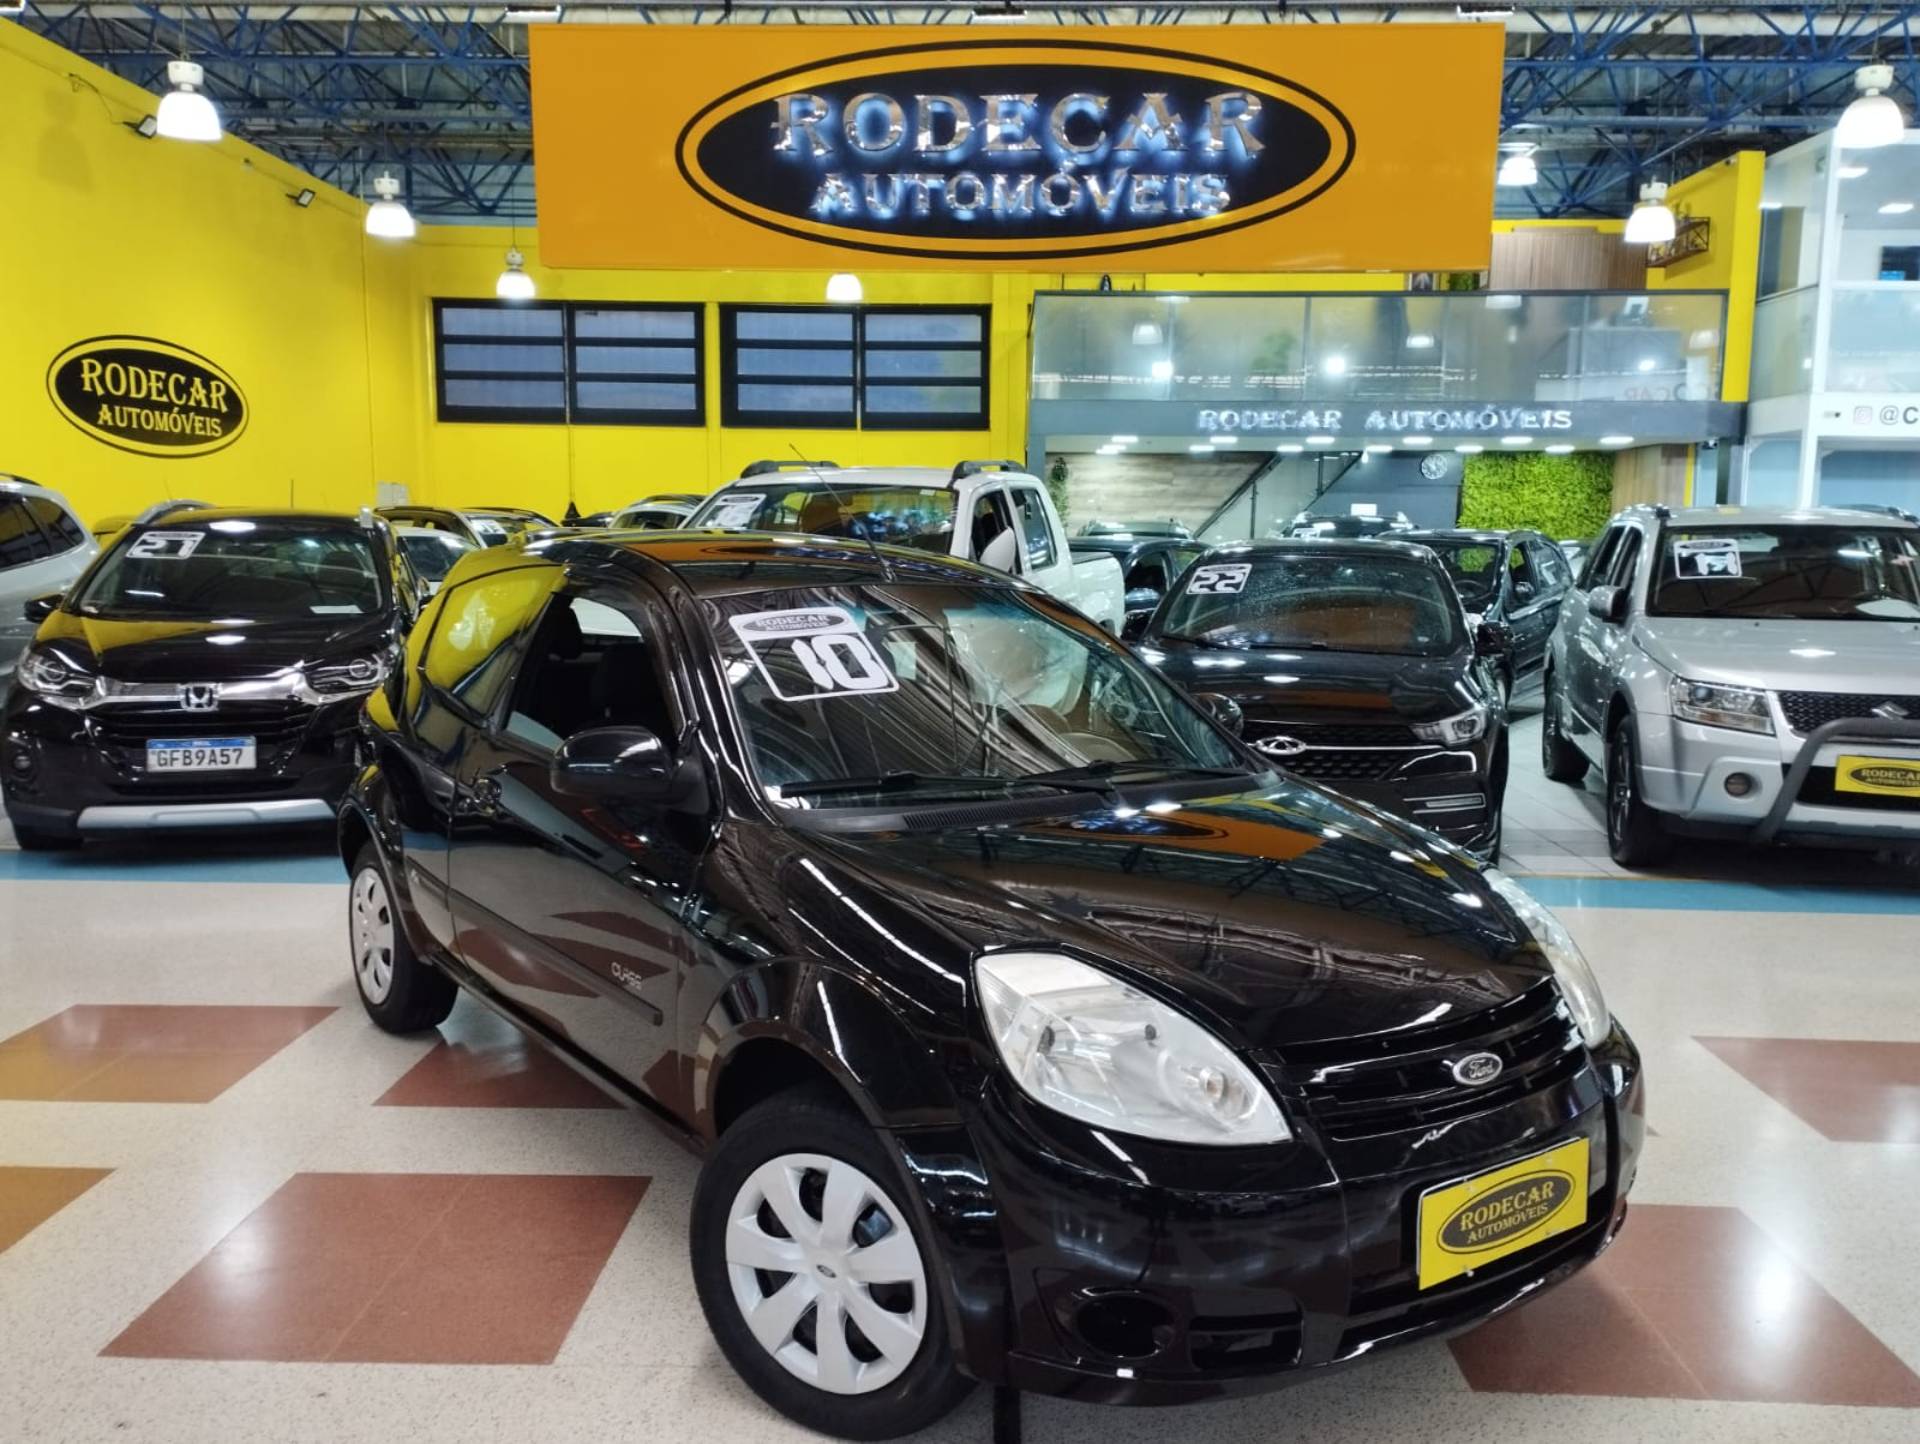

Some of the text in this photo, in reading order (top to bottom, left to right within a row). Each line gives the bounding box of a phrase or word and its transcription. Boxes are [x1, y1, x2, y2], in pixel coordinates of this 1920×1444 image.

[769, 91, 1266, 159] RODECAR
[809, 165, 1231, 217] AUTOMÓVEIS
[81, 358, 229, 413] RODECAR
[97, 403, 223, 437] AUTOMÓVEIS
[1199, 404, 1573, 431] RODECAR AUTOMÓVEIS
[1189, 571, 1245, 593] 22
[791, 634, 889, 690] 10
[157, 748, 244, 768] GFB9A57
[1861, 768, 1920, 781] RODECA
[1468, 1059, 1495, 1079] Ford
[1460, 1181, 1555, 1232] RODECAR
[1467, 1201, 1549, 1244] AUTOMÓVEIS
